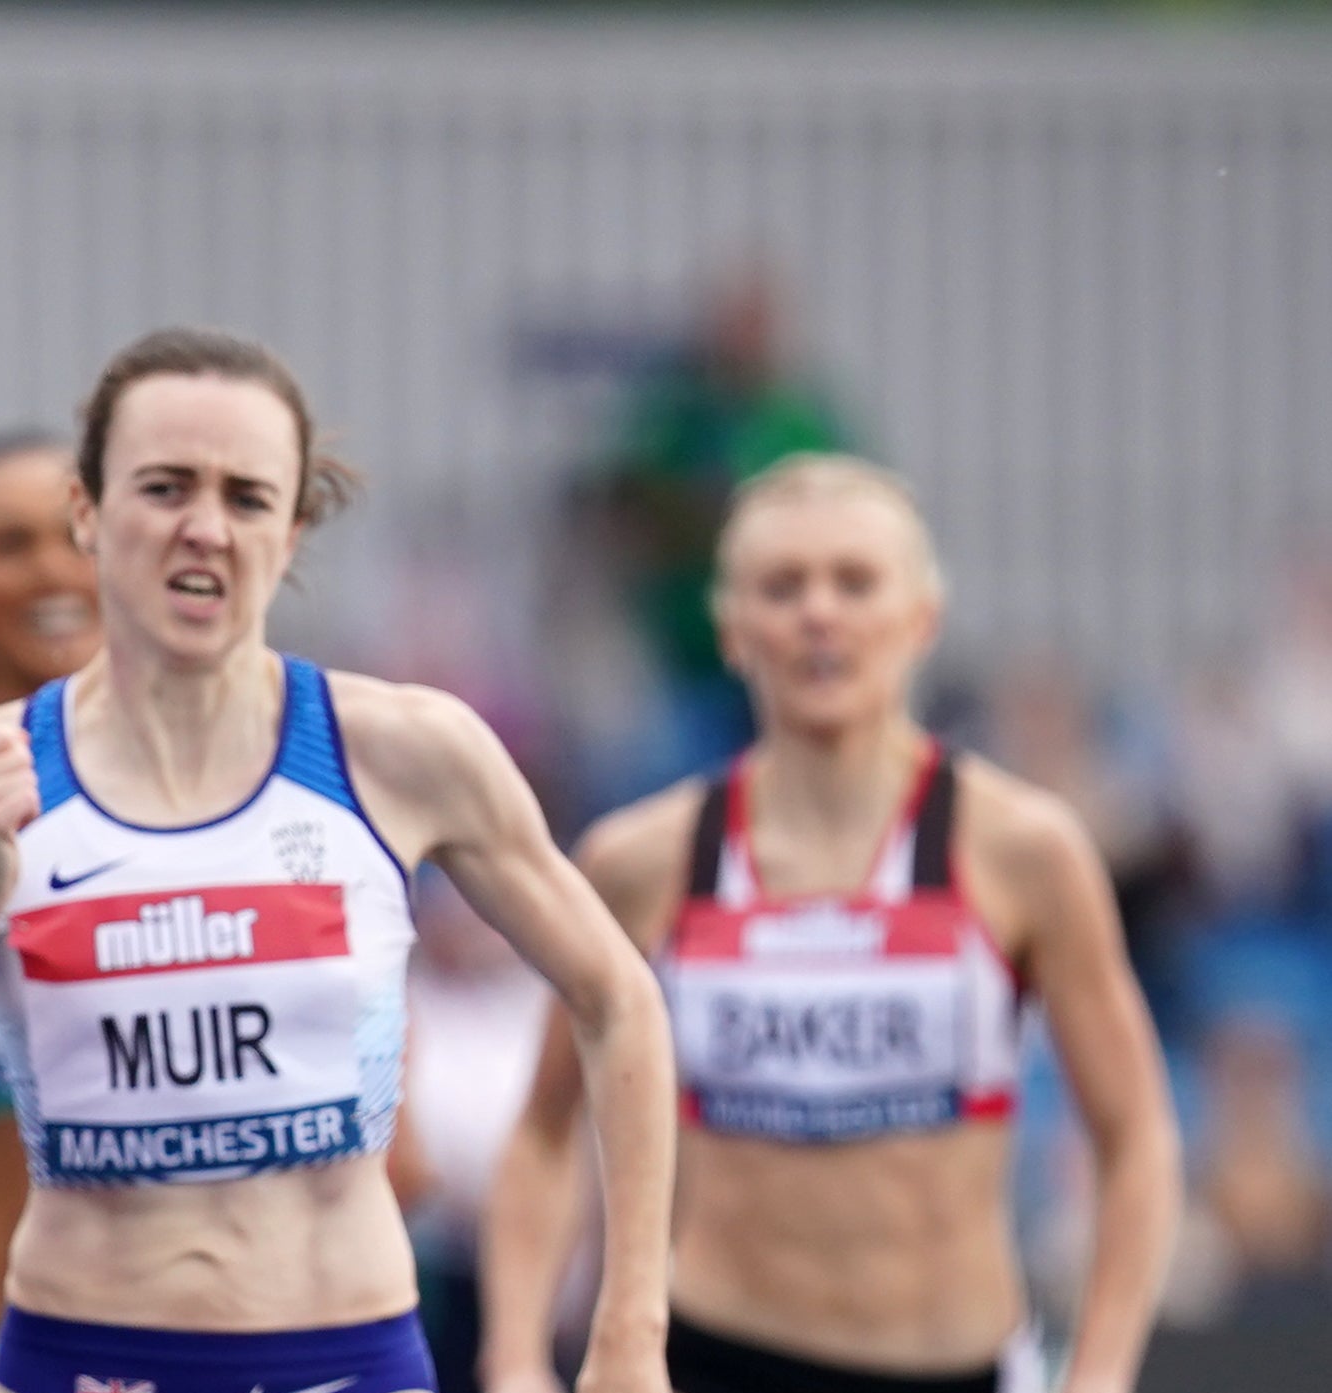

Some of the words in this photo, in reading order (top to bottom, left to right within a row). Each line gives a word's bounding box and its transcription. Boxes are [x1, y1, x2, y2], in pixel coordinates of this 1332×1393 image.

[94, 895, 260, 973] müller
[100, 1002, 278, 1091] MUIR
[708, 992, 925, 1072] BAKER
[57, 1106, 345, 1170] MANCHESTER
